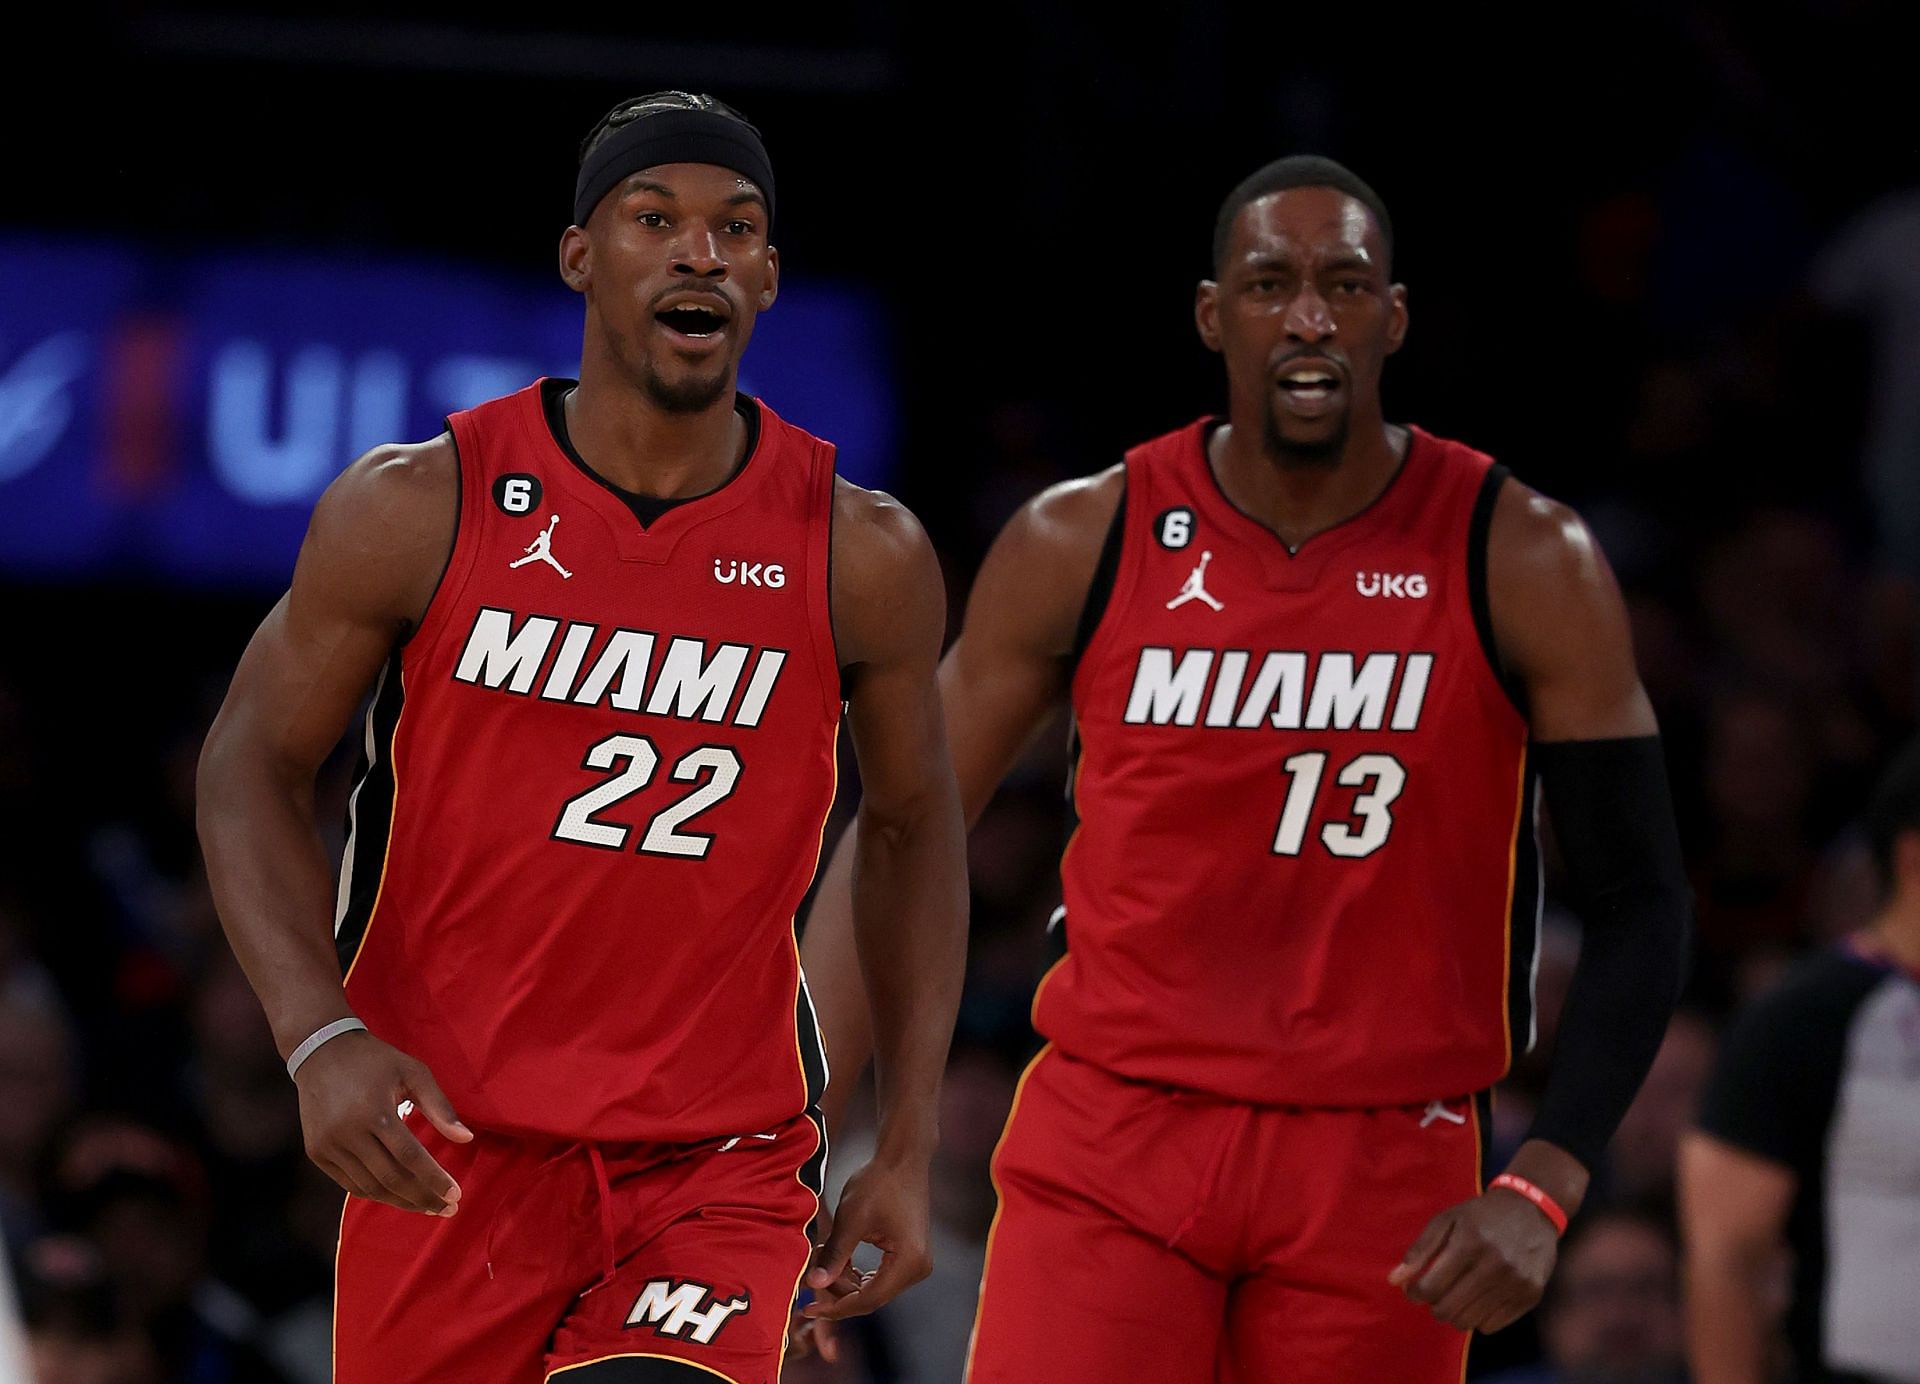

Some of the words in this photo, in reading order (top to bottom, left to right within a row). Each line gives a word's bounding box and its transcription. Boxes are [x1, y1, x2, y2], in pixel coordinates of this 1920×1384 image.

[503, 479, 532, 512] 6
[1161, 511, 1192, 548] 6
[455, 608, 786, 728] MIAMI
[1123, 647, 1434, 731] MIAMI
[553, 734, 741, 857] 22
[1272, 752, 1407, 858] 13
